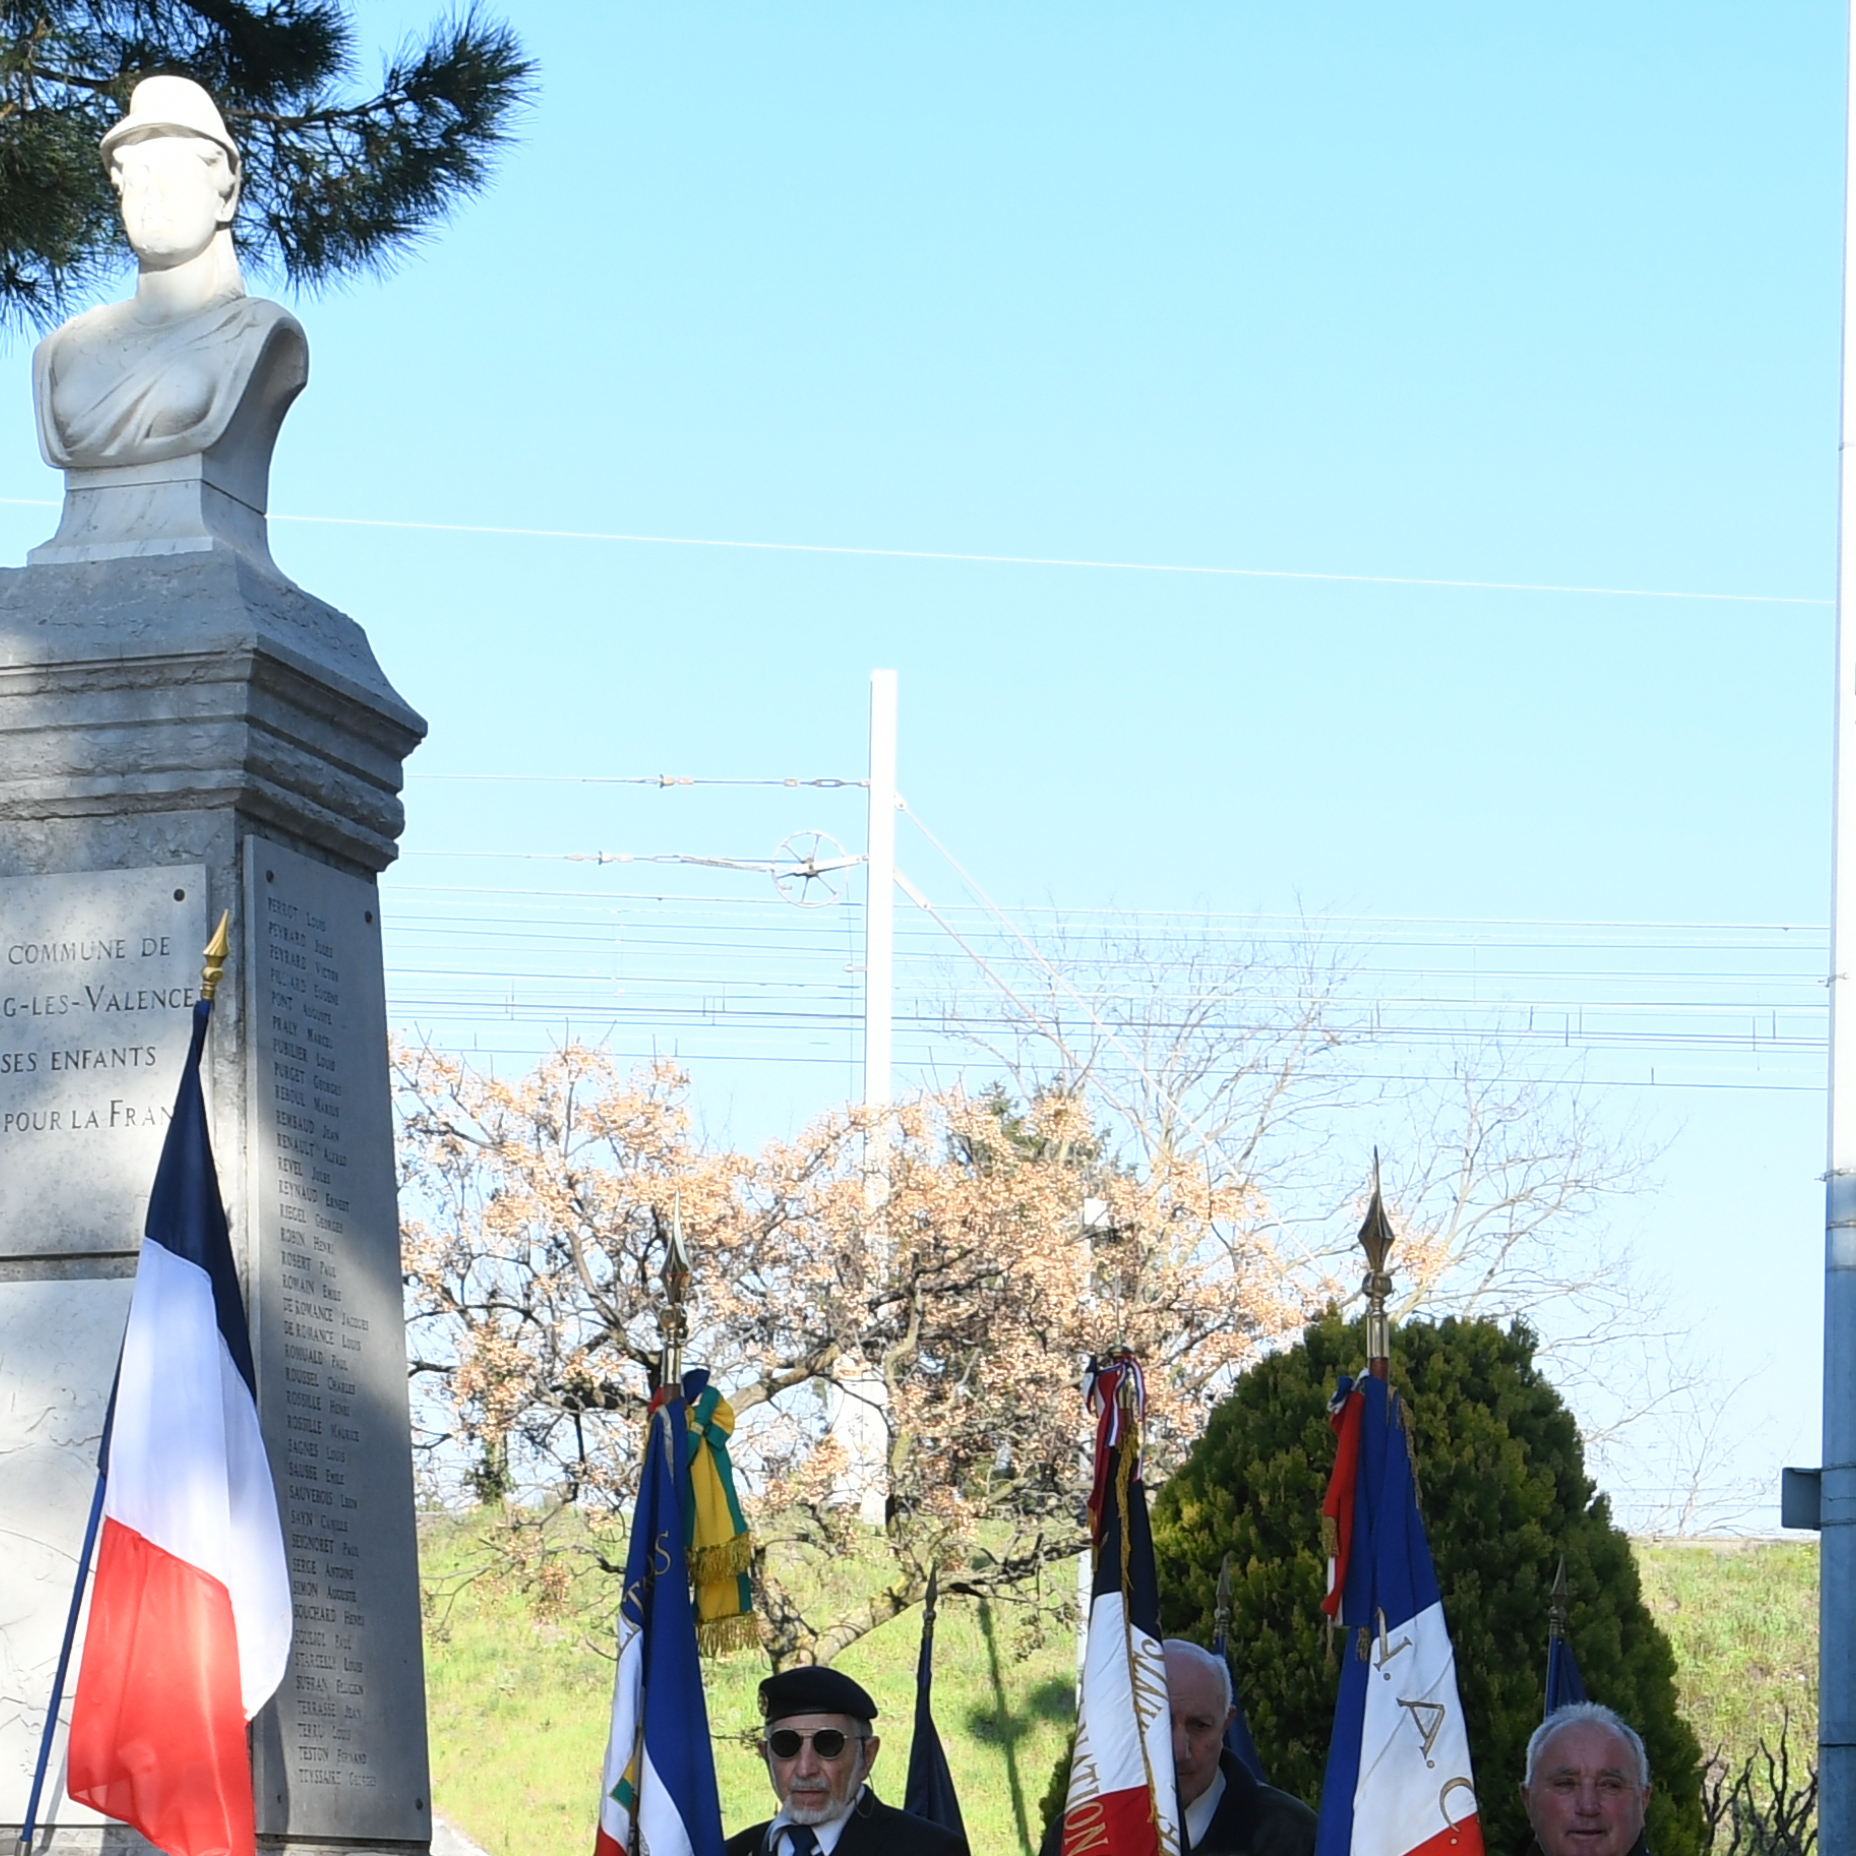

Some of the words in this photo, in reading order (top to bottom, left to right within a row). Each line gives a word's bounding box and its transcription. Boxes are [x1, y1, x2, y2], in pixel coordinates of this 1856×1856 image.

[8, 939, 126, 965] COMMUNE
[142, 937, 170, 956] DE
[0, 1052, 37, 1073] SES
[50, 1047, 156, 1070] ENFANTS
[4, 1112, 62, 1132] POUR
[71, 1109, 98, 1129] LA
